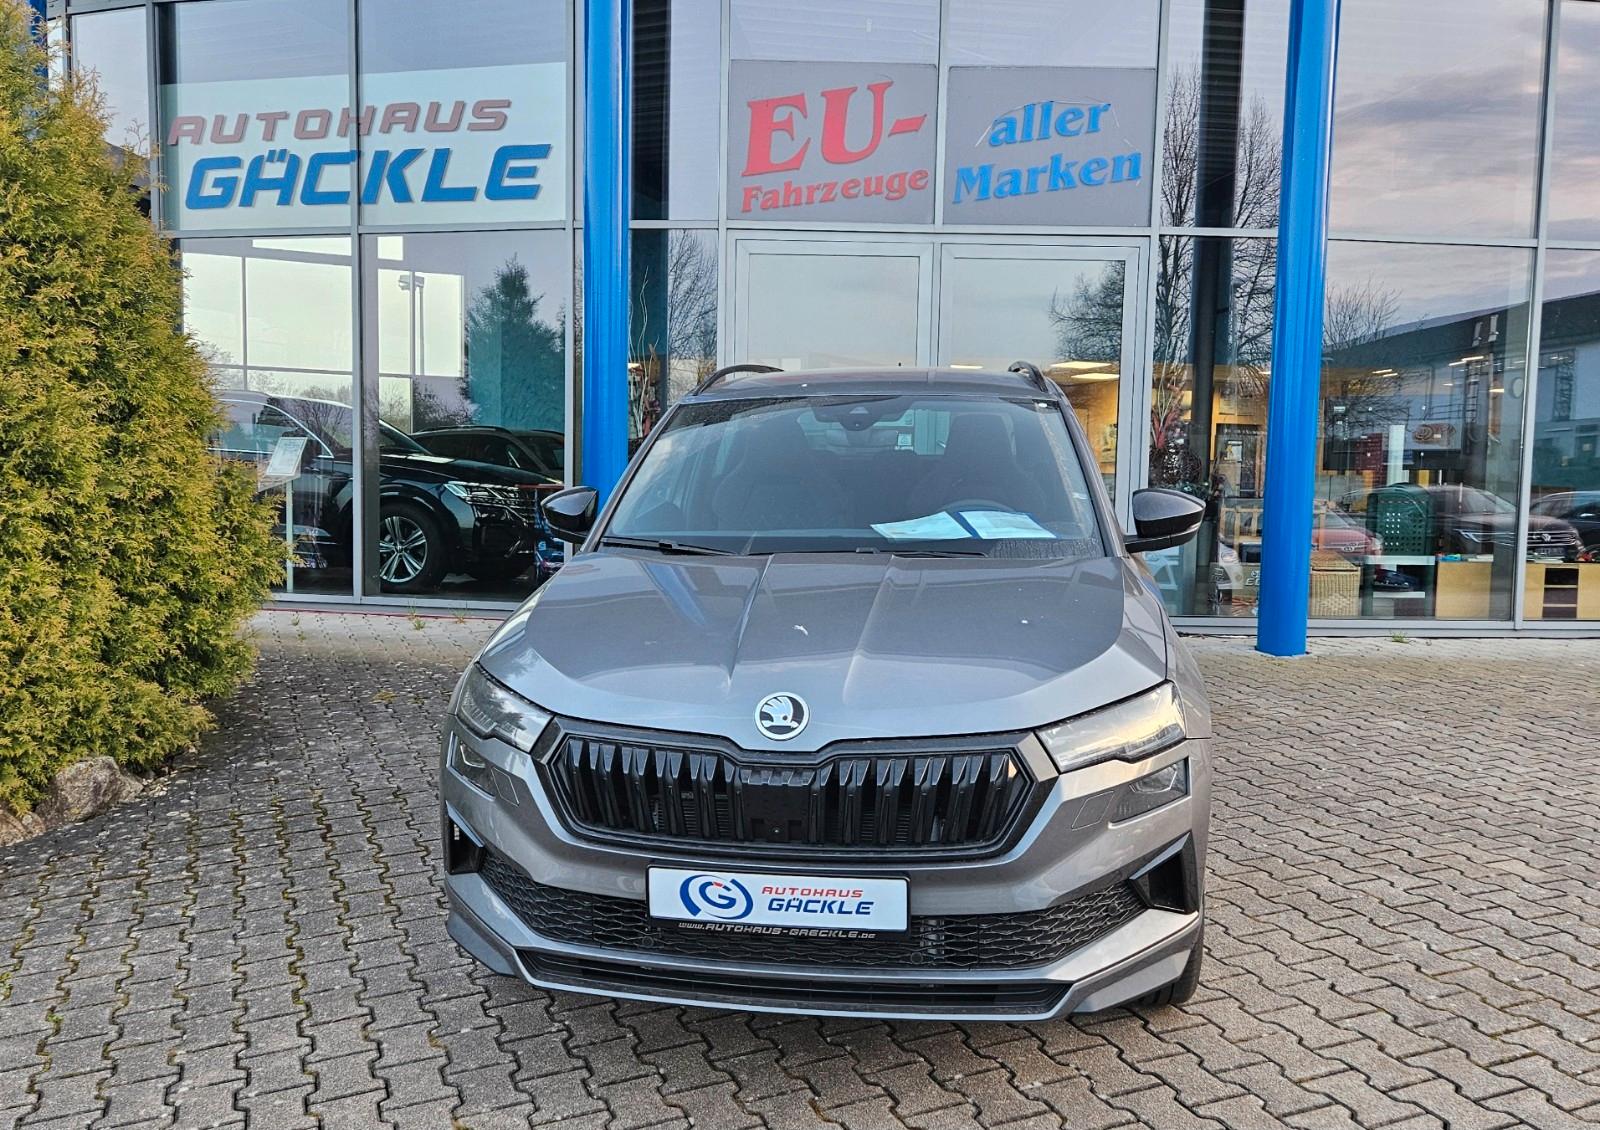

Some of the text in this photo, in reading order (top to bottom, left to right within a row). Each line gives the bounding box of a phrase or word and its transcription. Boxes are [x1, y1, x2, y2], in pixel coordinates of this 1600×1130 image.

[168, 98, 512, 146] AUTOHAUS
[741, 81, 927, 177] EU-
[989, 100, 1111, 148] aller
[186, 144, 552, 209] GÄCKLE
[741, 169, 928, 213] Fahrzeuge
[953, 151, 1142, 204] Marken
[762, 886, 863, 898] AUTOHAUS
[768, 897, 874, 915] GÄCKLE
